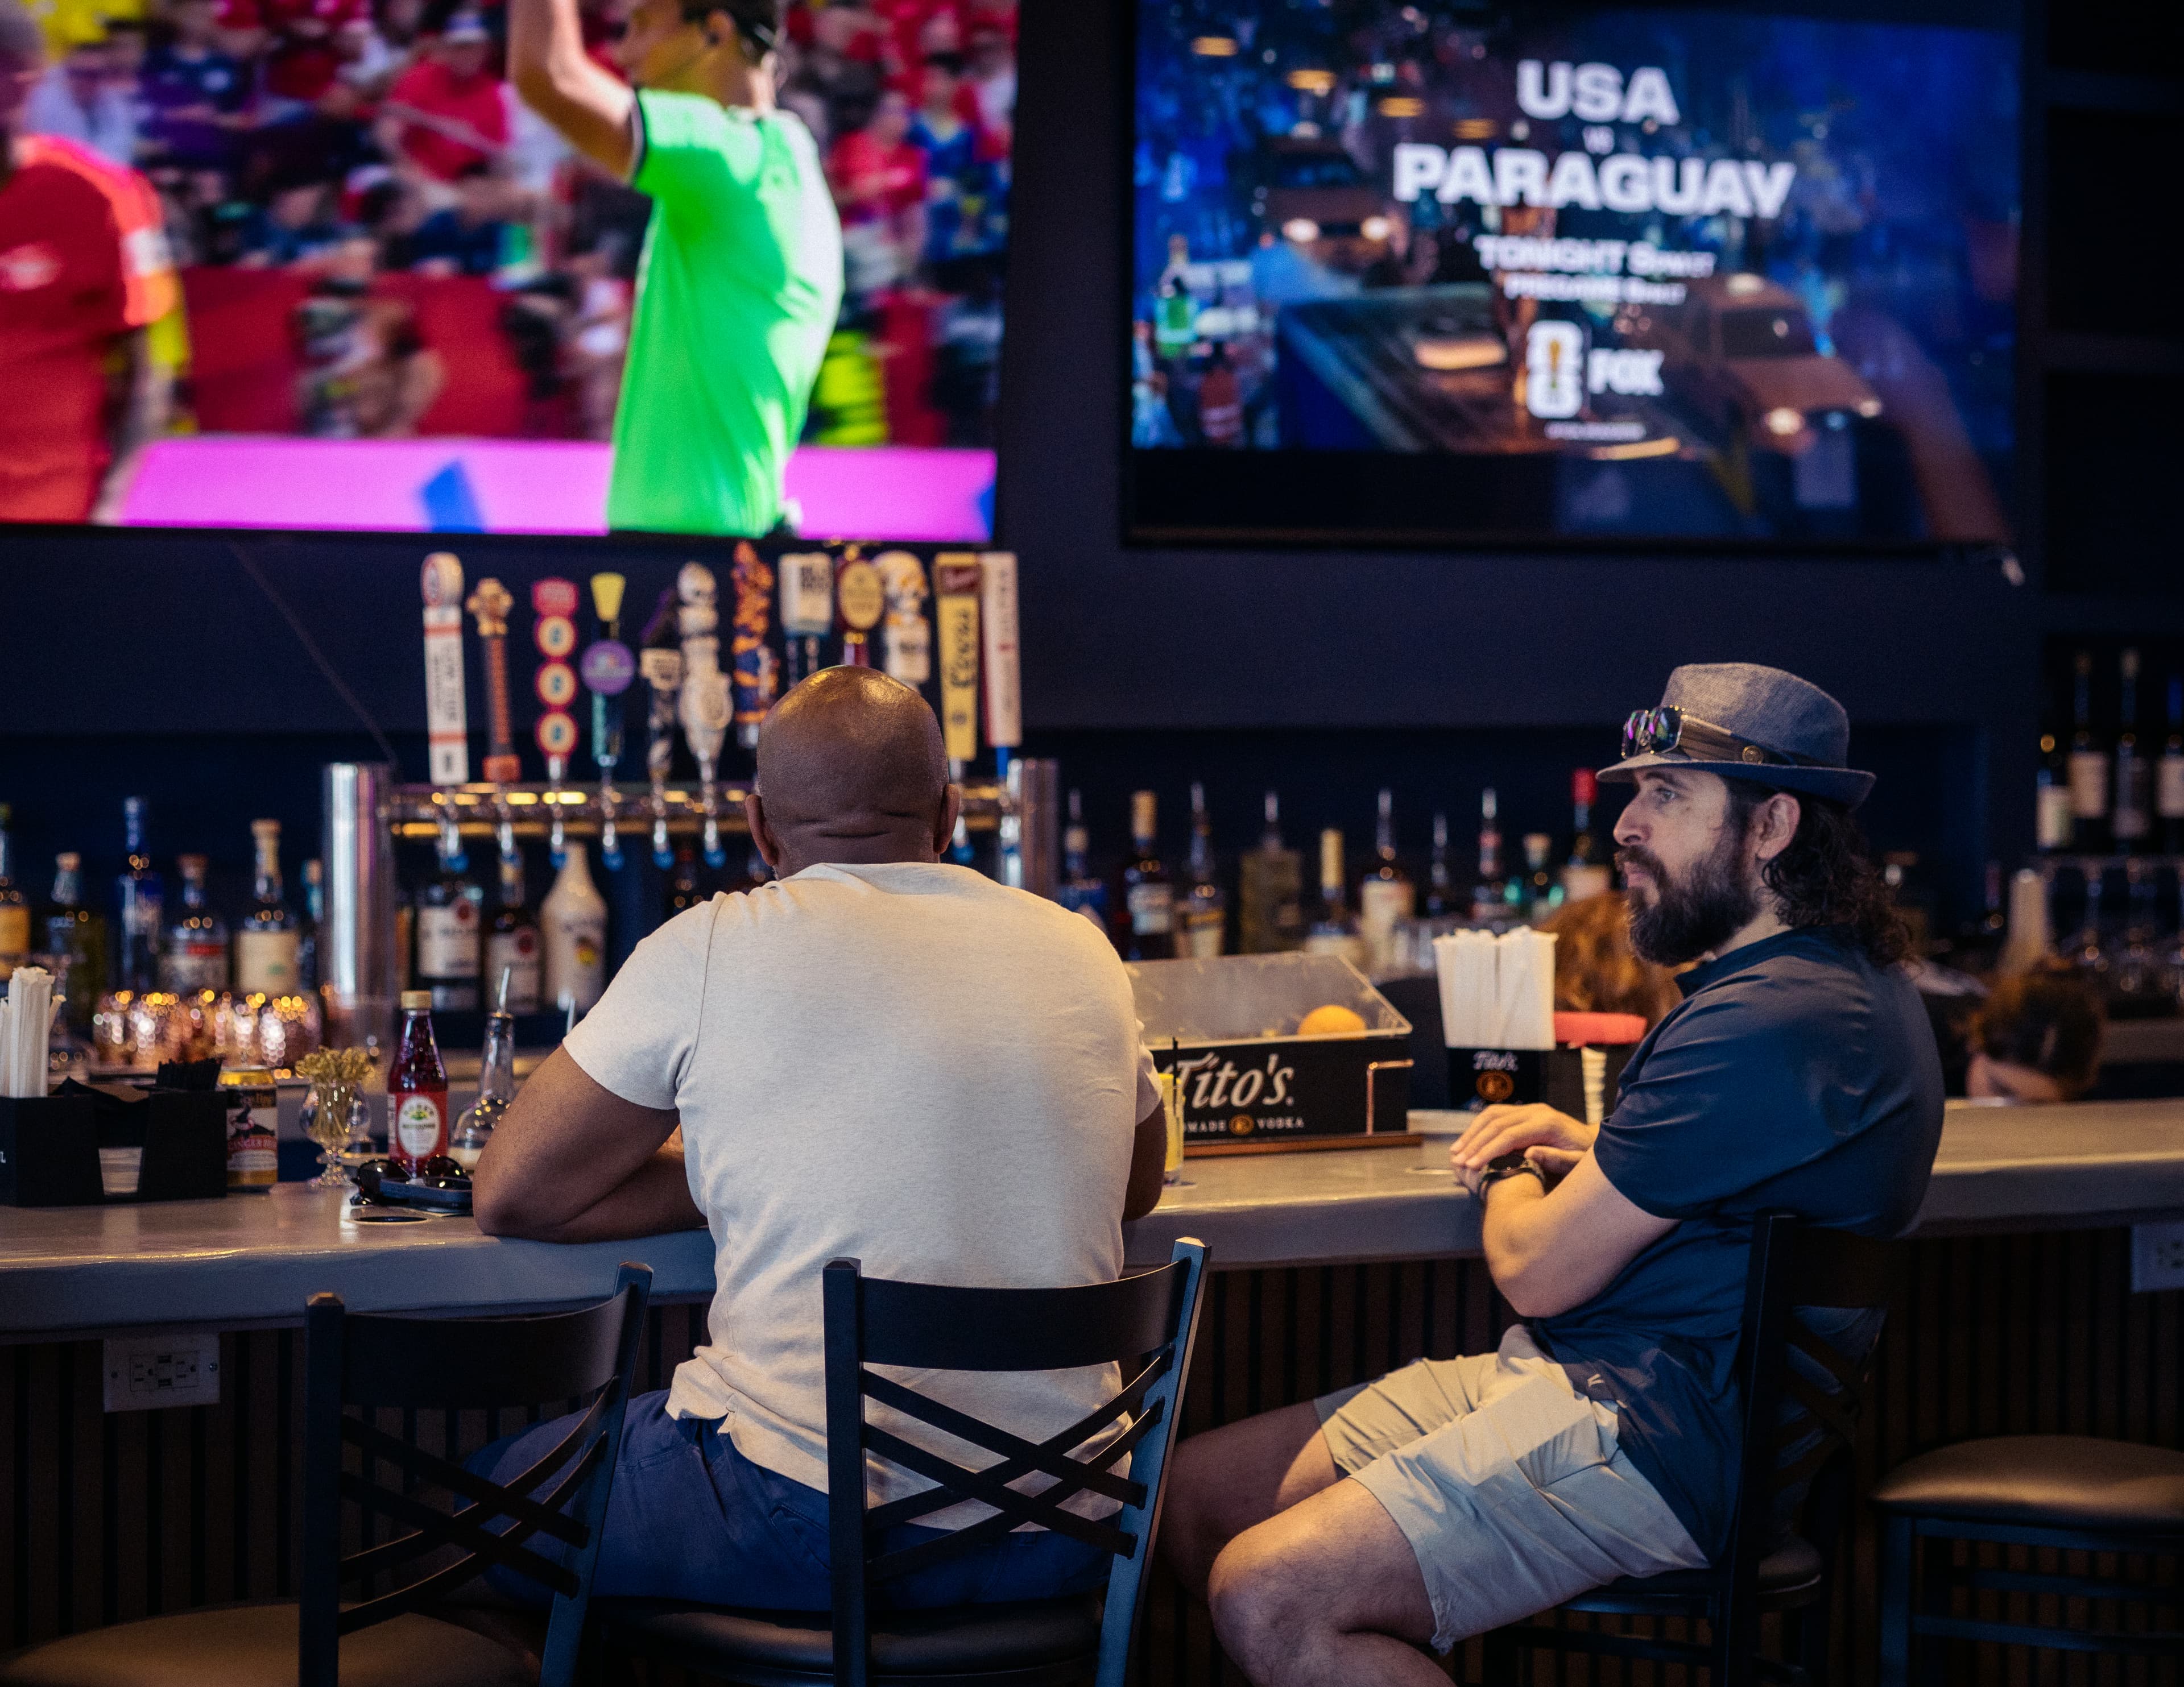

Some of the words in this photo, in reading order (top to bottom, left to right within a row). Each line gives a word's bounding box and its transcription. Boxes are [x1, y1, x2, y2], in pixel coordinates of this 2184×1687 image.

[1516, 59, 1681, 126] USA
[1393, 142, 1797, 219] PARAGUAY
[1474, 234, 1627, 275] TONIGHT
[1588, 348, 1664, 396] FOX
[1161, 1052, 1294, 1108] Tito's
[1184, 1119, 1227, 1133] MADE
[1256, 1116, 1305, 1130] VODKA
